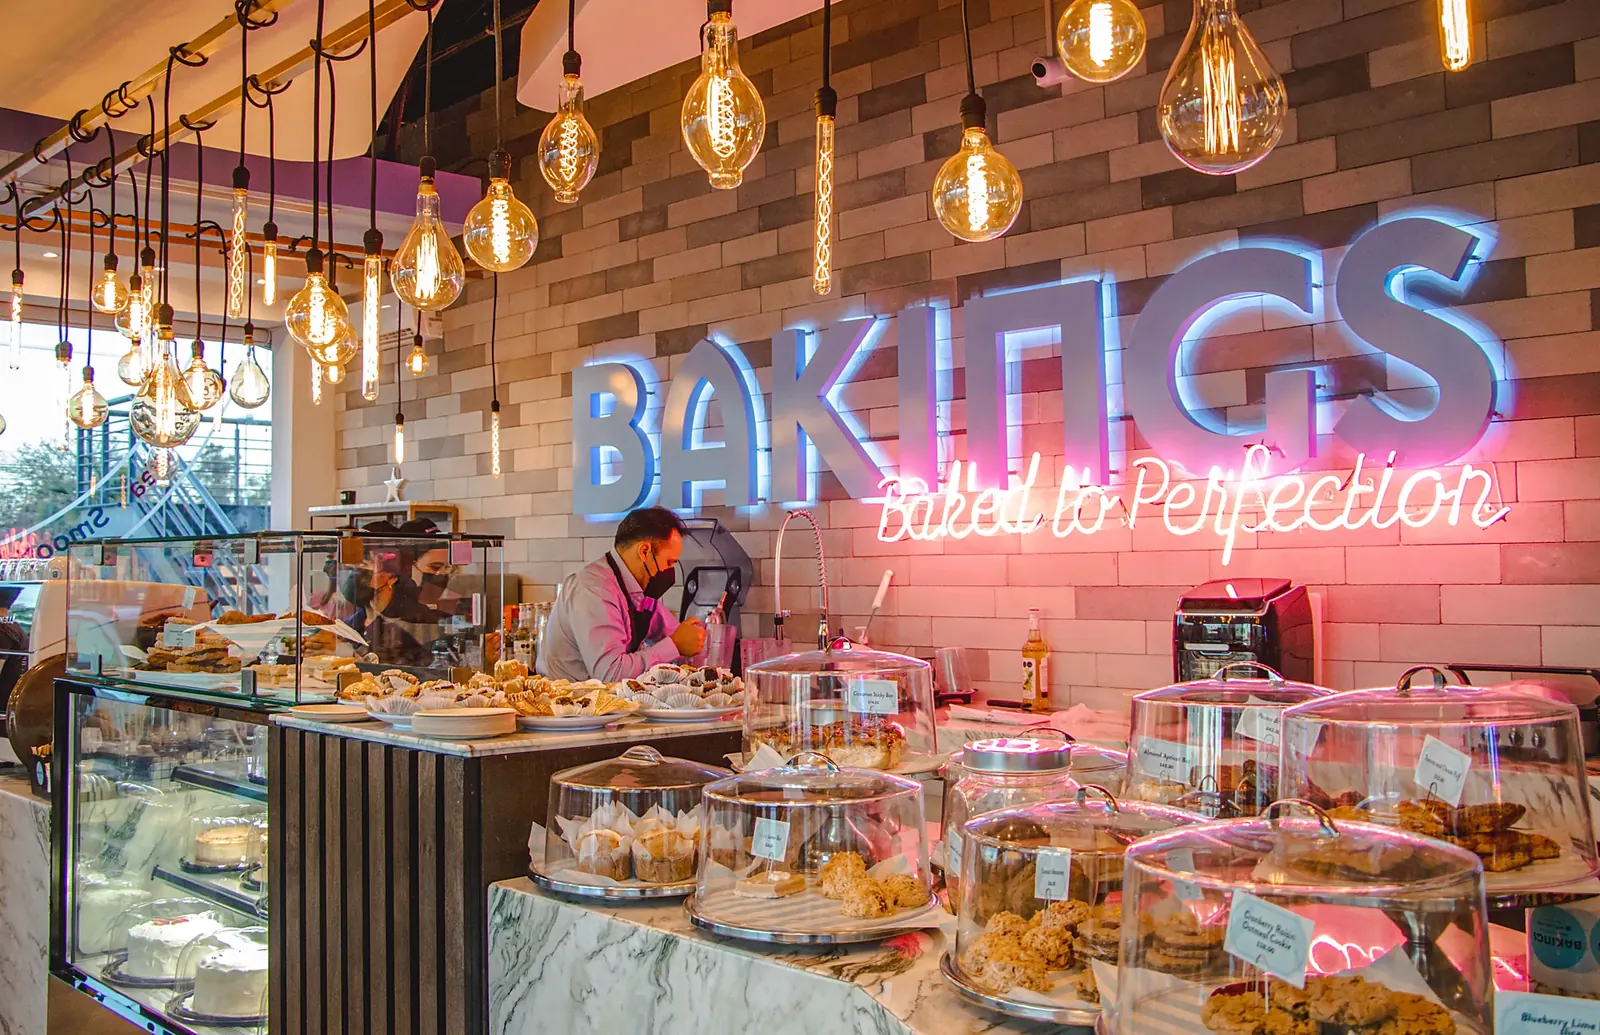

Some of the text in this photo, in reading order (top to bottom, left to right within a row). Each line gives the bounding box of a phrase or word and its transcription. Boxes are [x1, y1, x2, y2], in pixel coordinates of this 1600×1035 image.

[571, 213, 1504, 519] BAKINGS
[877, 444, 1511, 566] Baked to Perfection
[1143, 749, 1162, 758] Almond
[1269, 934, 1292, 951] Cookie
[1521, 1011, 1596, 1032] Blueberry Lime
